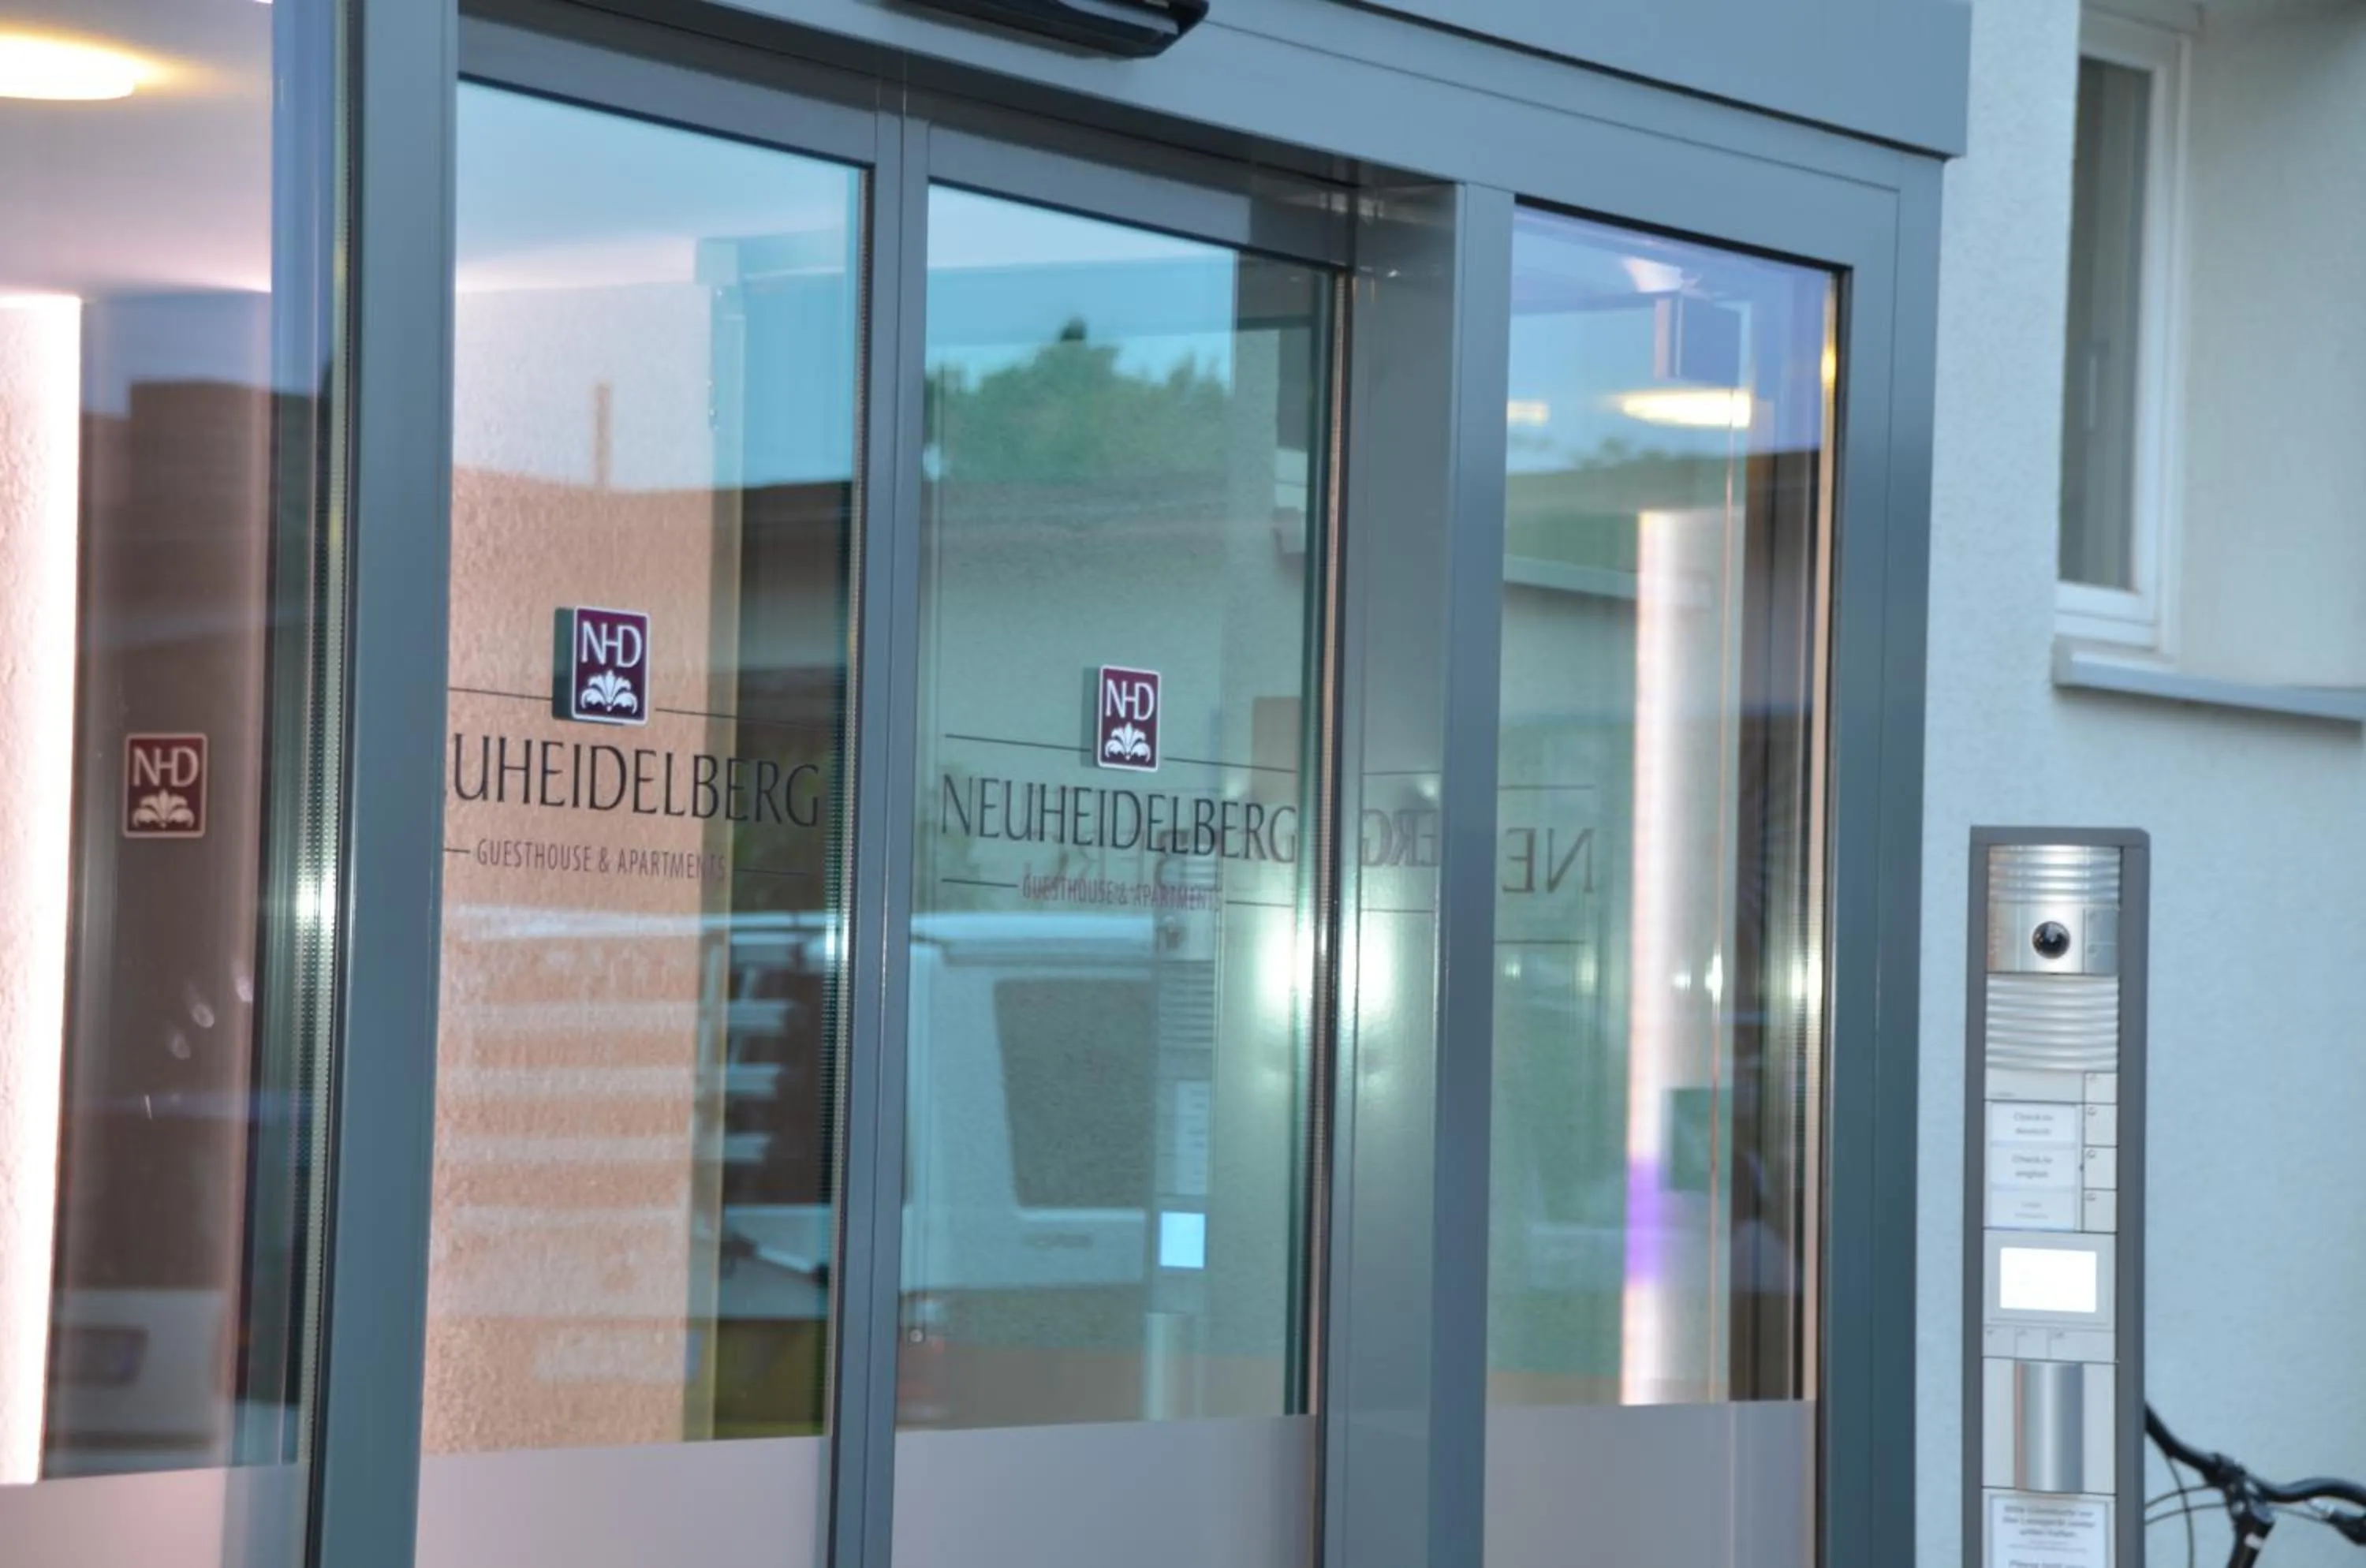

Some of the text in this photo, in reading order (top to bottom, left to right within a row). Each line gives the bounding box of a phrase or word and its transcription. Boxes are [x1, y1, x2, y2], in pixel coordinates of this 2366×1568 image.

[580, 621, 642, 669] NHD
[1105, 678, 1155, 721] NHD
[132, 745, 199, 787] NHD
[453, 733, 819, 827] UHEIDELBERG
[942, 773, 1297, 864] NEUHEIDELBERG
[476, 838, 726, 883] GUESTHOUSE & APARTMENTS
[1022, 872, 1114, 905] GUESTHOUSE
